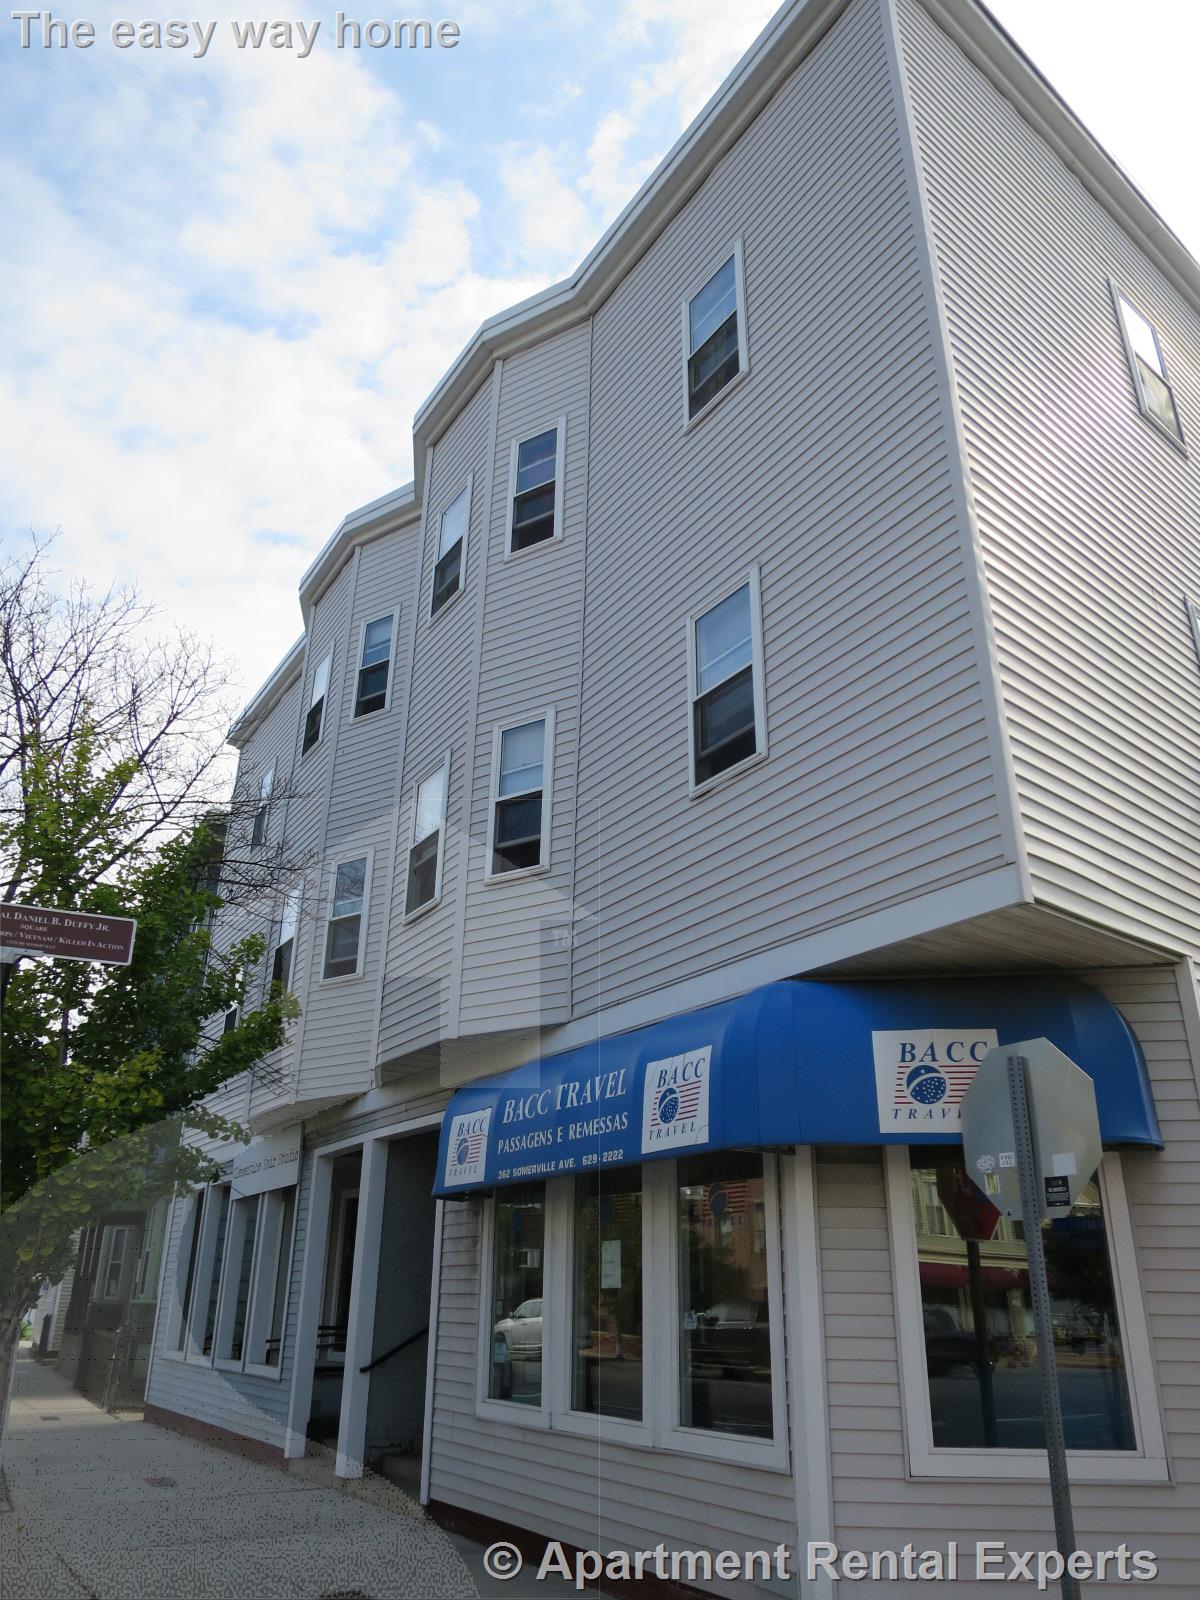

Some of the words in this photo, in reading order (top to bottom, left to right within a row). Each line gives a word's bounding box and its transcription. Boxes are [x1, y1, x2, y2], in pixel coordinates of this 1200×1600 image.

[899, 1040, 989, 1063] BACC
[657, 1056, 706, 1088] BACC
[502, 1088, 551, 1125] BACC
[554, 1068, 627, 1111] TRAVEL
[892, 1107, 962, 1120] TRAV
[456, 1115, 488, 1138] BACC
[497, 1128, 553, 1155] PASSAGENS
[557, 1124, 564, 1143] E
[568, 1111, 629, 1140] REMESSAS
[649, 1121, 697, 1142] TRAVEL
[512, 1159, 557, 1178] SOMERVILLE
[558, 1156, 577, 1170] AVE.
